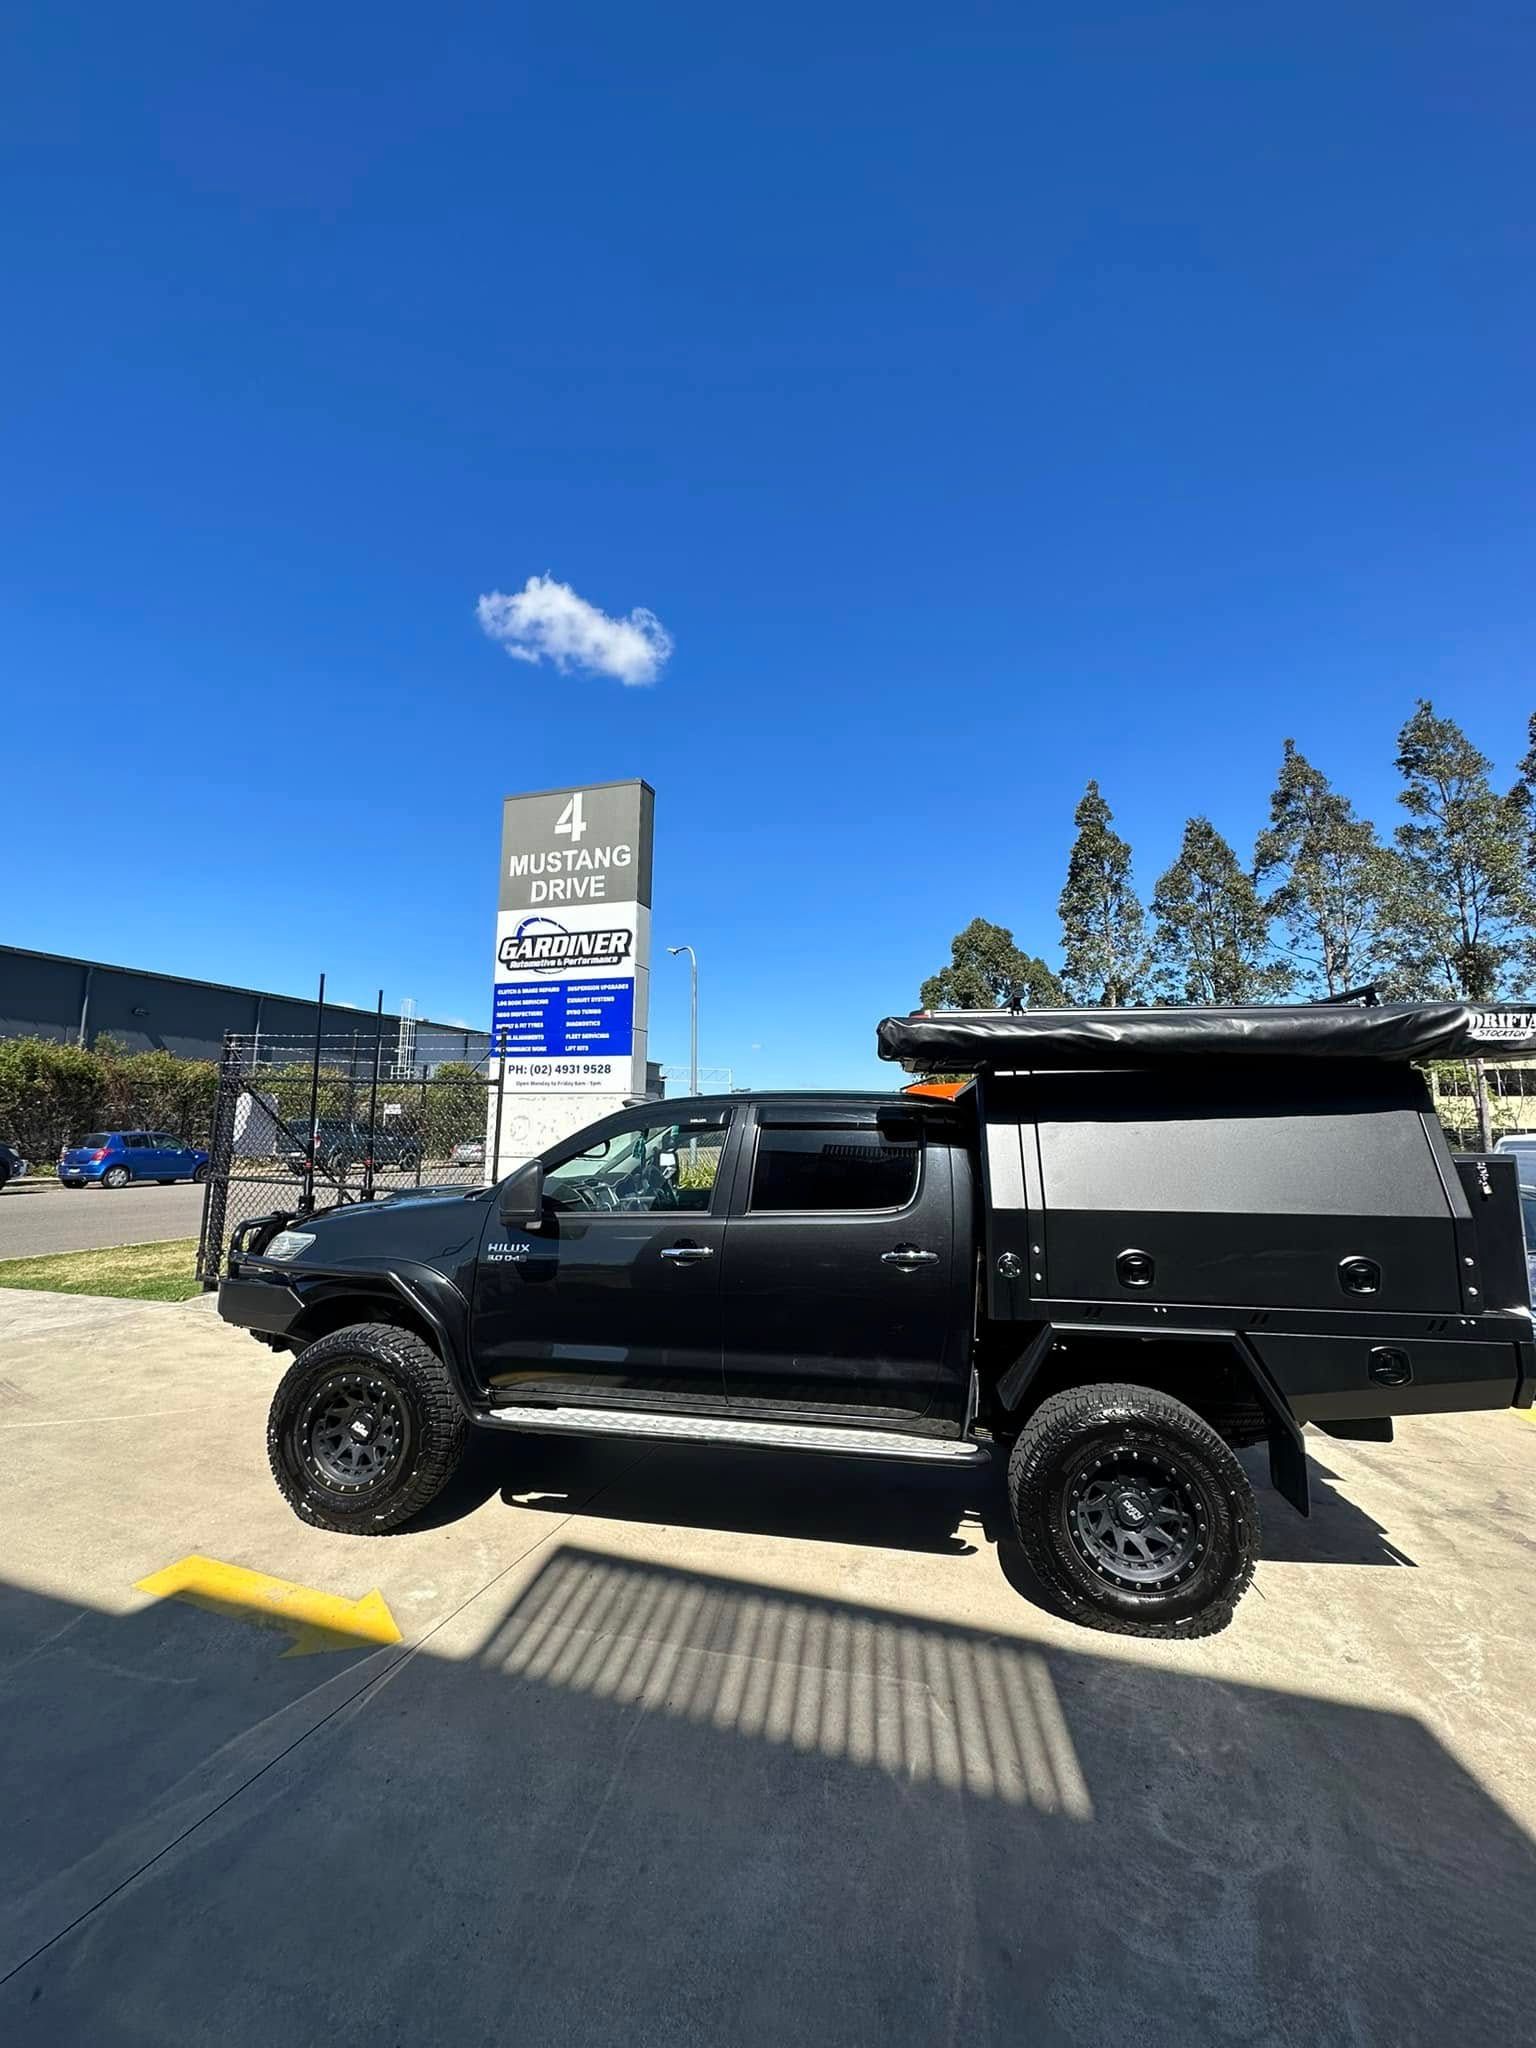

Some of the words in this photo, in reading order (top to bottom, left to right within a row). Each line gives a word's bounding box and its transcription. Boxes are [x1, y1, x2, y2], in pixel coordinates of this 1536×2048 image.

[554, 792, 586, 842] 4
[509, 844, 631, 877] MUSTANG
[530, 875, 606, 903] DRIVE
[499, 931, 630, 960] GARDINER
[509, 958, 556, 969] Automotive
[564, 956, 618, 967] Performance
[1479, 1029, 1527, 1038] STOCKTON
[508, 1064, 527, 1075] PH:
[530, 1064, 552, 1076] (02)
[555, 1064, 580, 1074] 4931
[583, 1064, 611, 1074] 9528
[487, 1243, 531, 1253] HILUX
